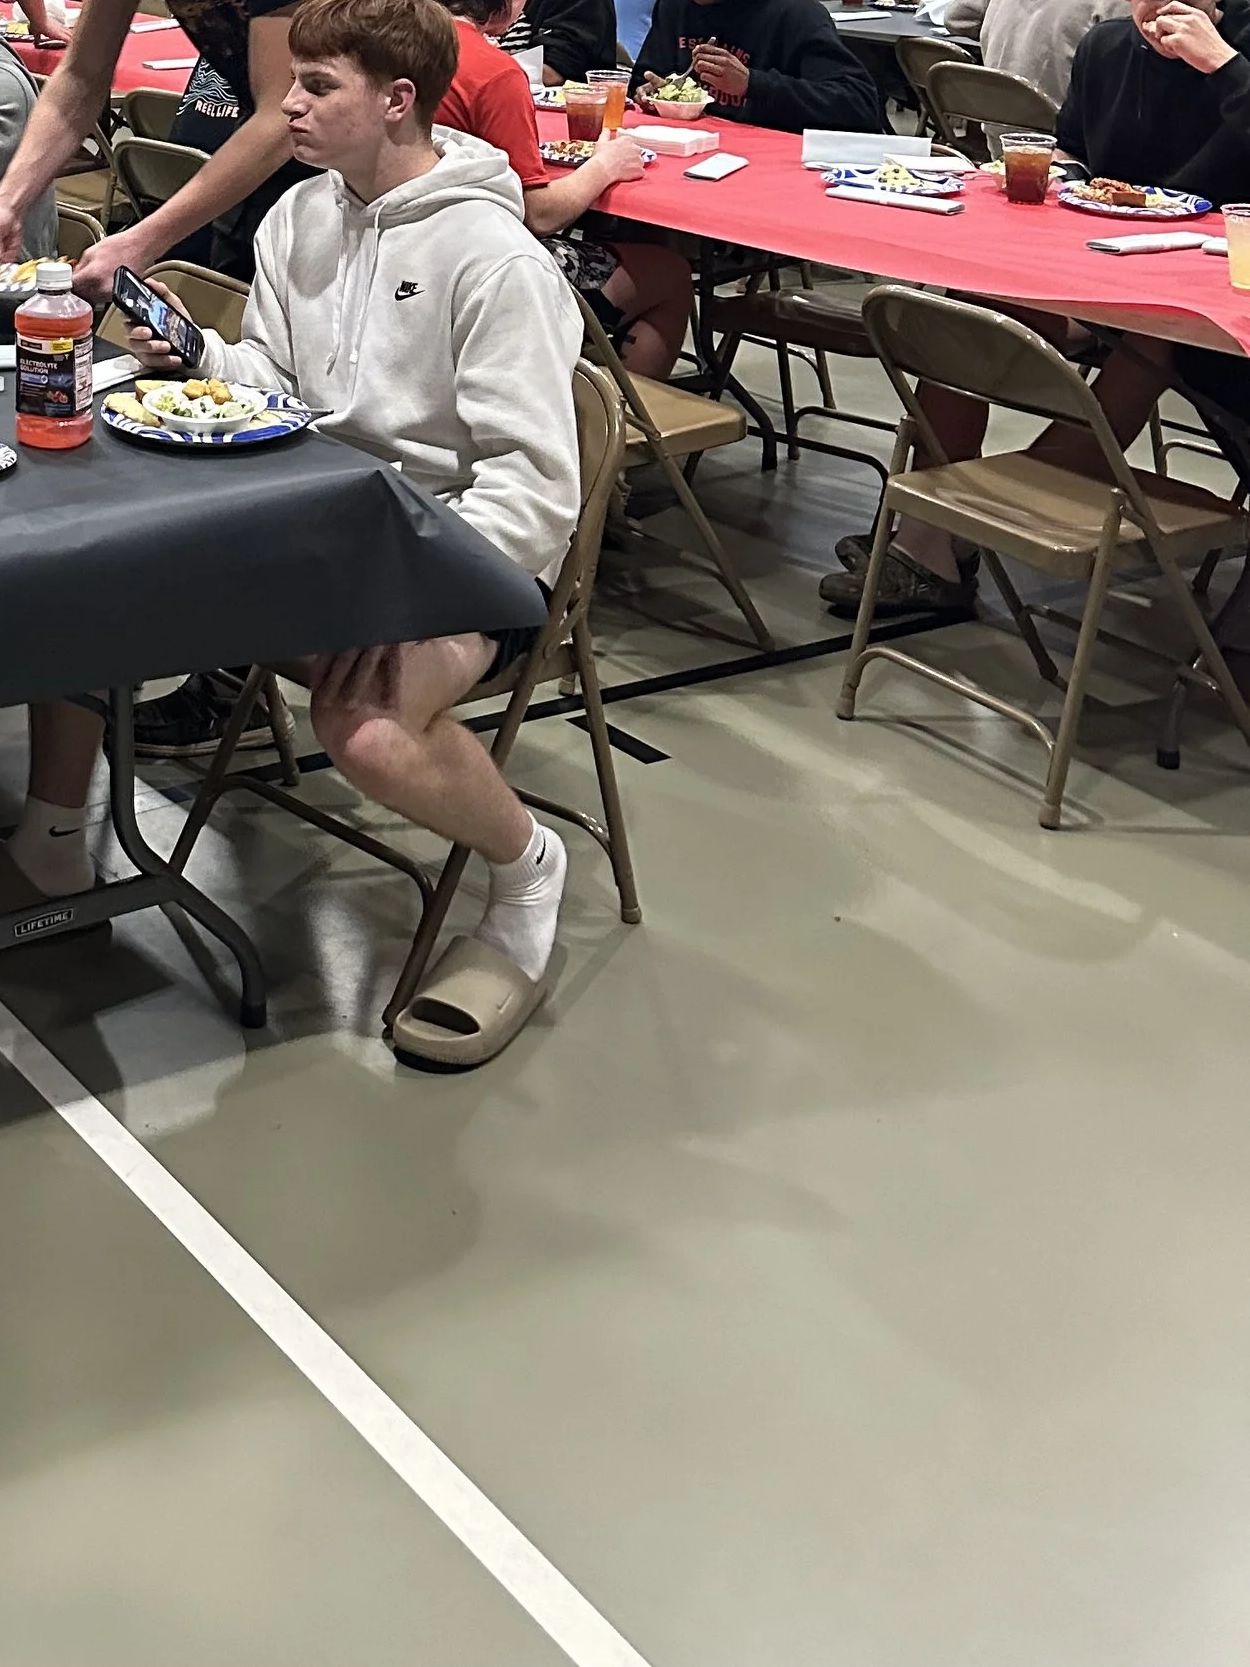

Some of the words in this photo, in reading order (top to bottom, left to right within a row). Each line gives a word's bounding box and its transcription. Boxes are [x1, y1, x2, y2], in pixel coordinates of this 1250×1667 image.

[400, 280, 419, 294] NIKE
[20, 358, 58, 370] ELECTROLYTE
[20, 365, 49, 375] SOLUTION
[21, 911, 69, 934] LIFETIME
